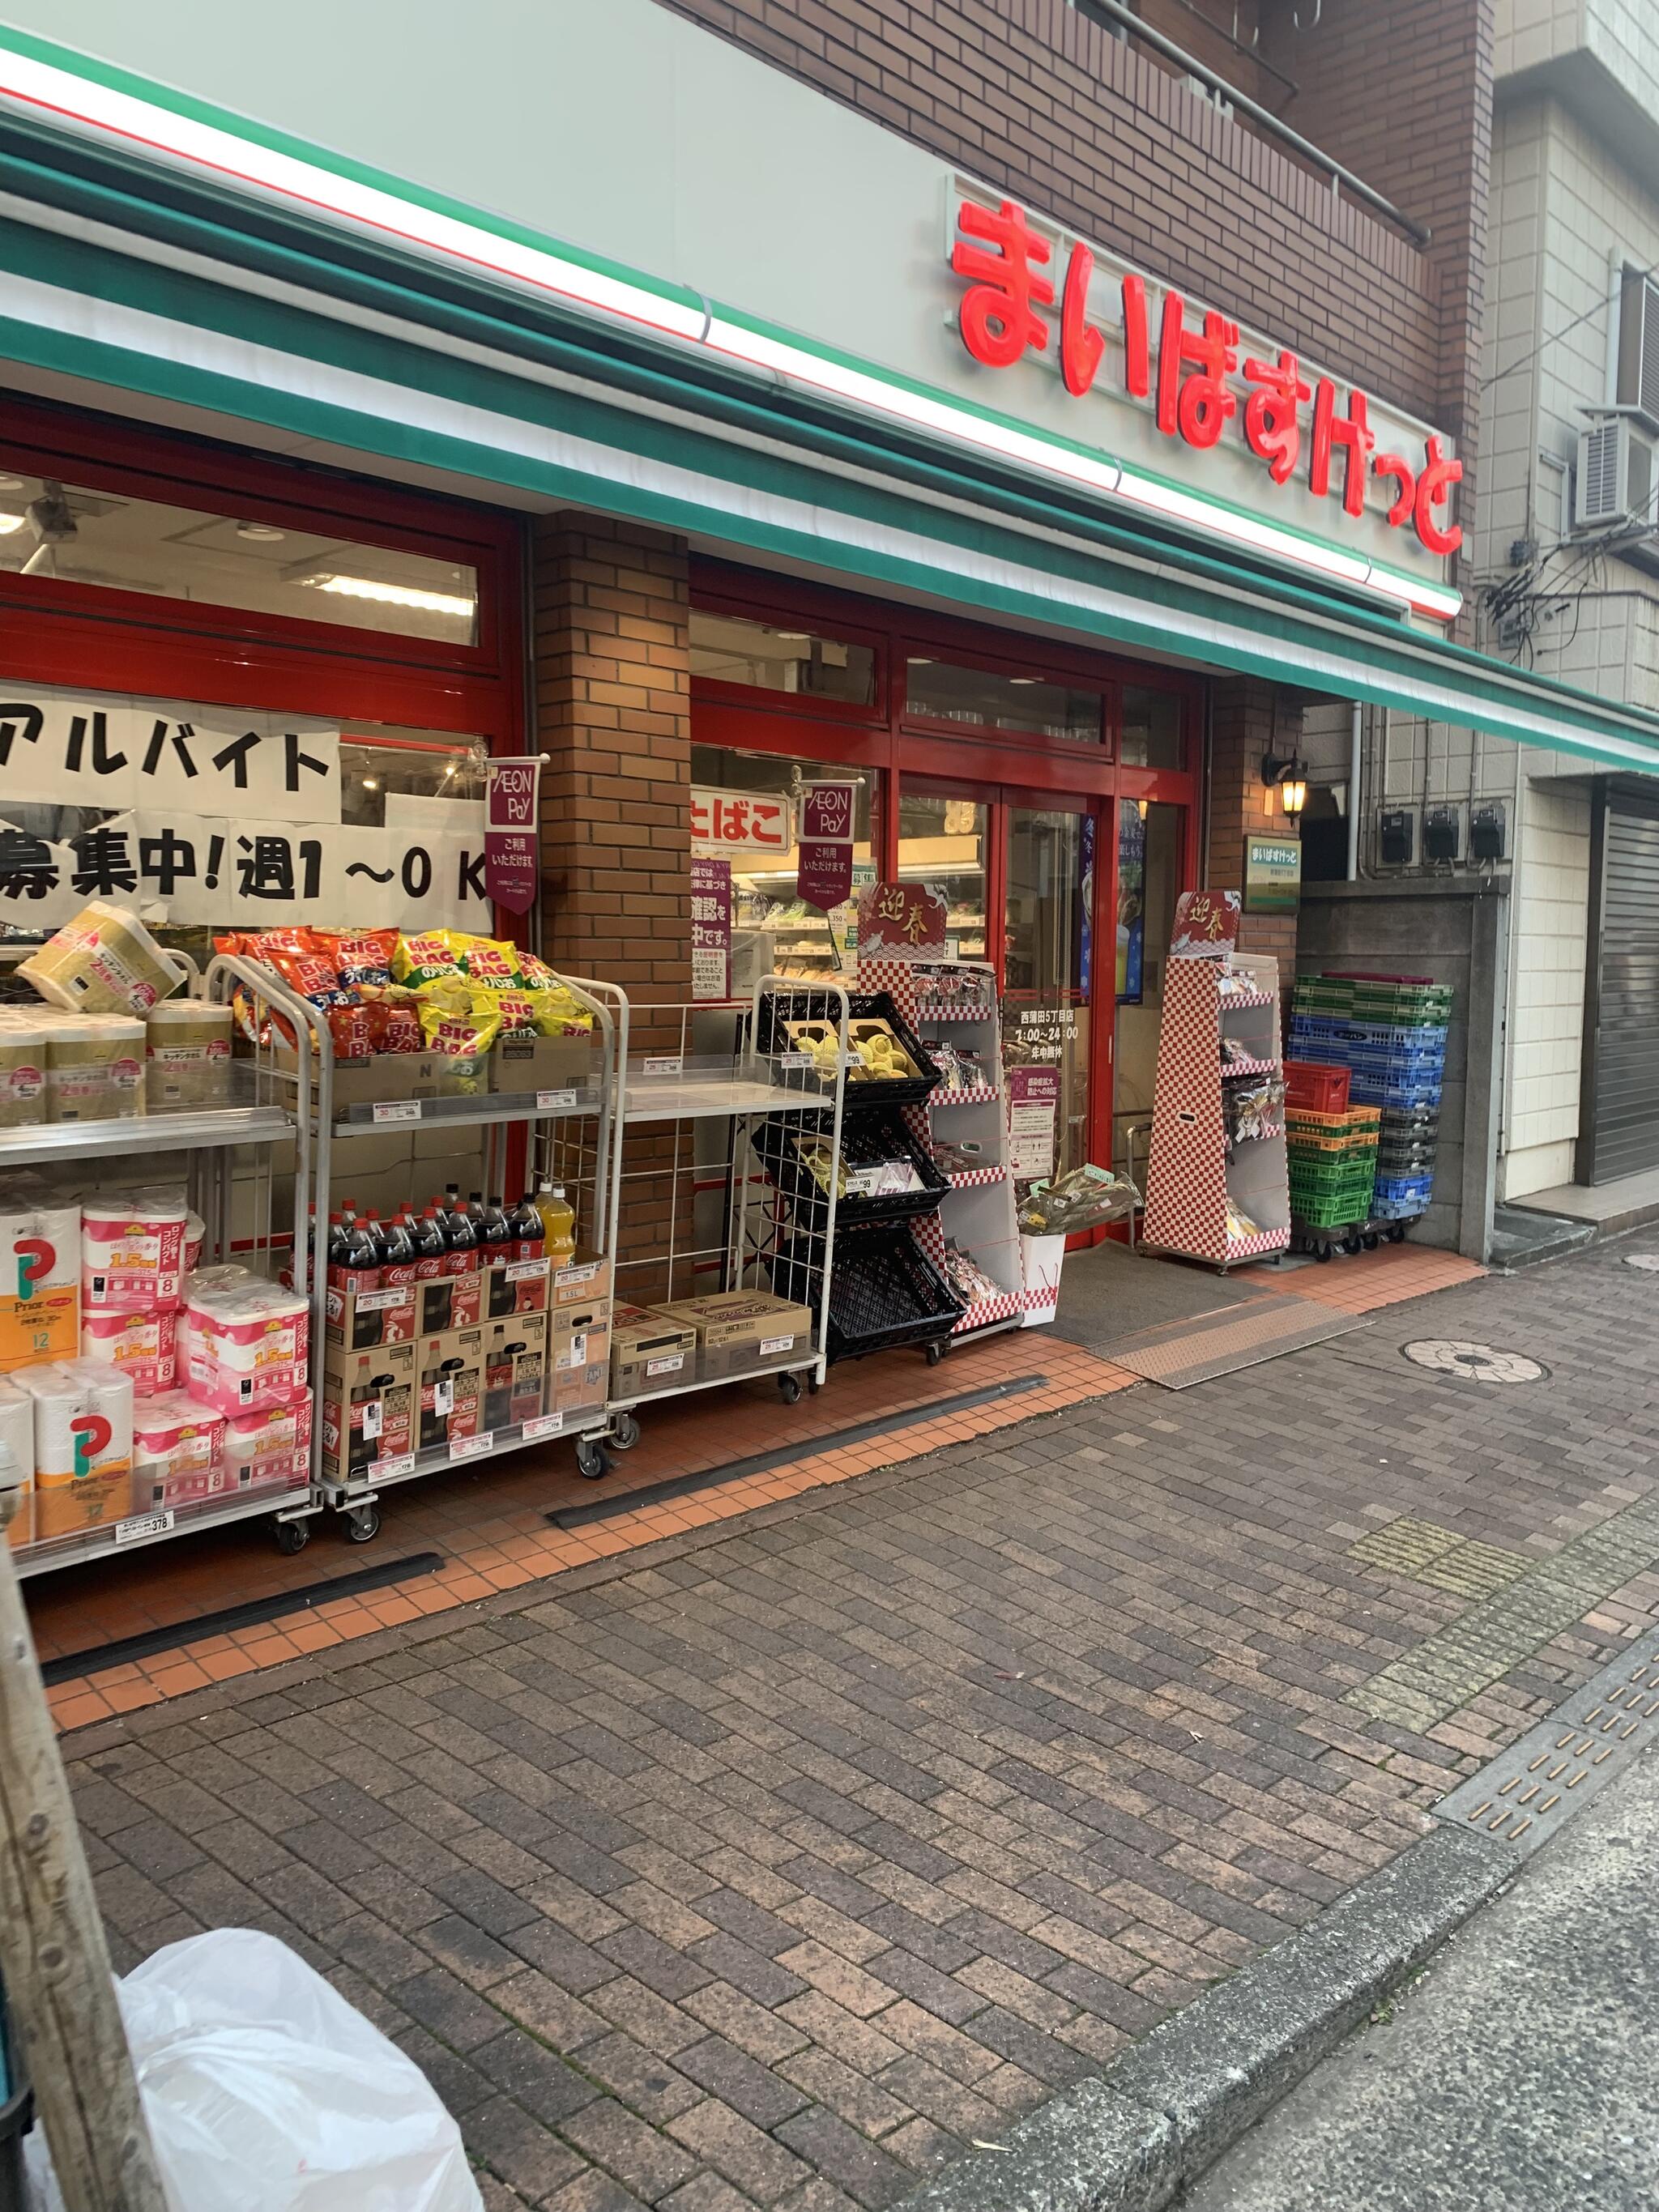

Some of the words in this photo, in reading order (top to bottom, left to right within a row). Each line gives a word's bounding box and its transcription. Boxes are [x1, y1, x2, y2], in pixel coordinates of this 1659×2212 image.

[951, 199, 1463, 556] まいばすけっと
[0, 702, 330, 792] アルバイト
[808, 791, 848, 810] AEON
[505, 837, 527, 851] ご利用
[815, 847, 838, 859] ご利用
[1252, 847, 1297, 864] まいばすけっと
[492, 854, 533, 868] いただけます。
[804, 861, 847, 874] いただけます。
[692, 923, 727, 946] 中です。
[339, 940, 382, 954] BIG
[407, 940, 443, 953] BIG
[410, 950, 455, 966] BAG
[470, 964, 511, 978] BAG
[1021, 1010, 1074, 1025] 西蒲田5丁目店
[438, 1022, 479, 1042] BIG
[1031, 1045, 1063, 1059] 年中無休
[863, 1179, 871, 1188] 99
[162, 1230, 172, 1265] コンパクト
[163, 1279, 173, 1293] 8
[14, 1302, 44, 1313] Prior
[33, 1332, 49, 1348] 12
[162, 1363, 172, 1376] 8
[298, 1367, 305, 1380] 8
[296, 1452, 307, 1467] 8
[212, 1473, 222, 1487] 8
[151, 1517, 168, 1532] 378
